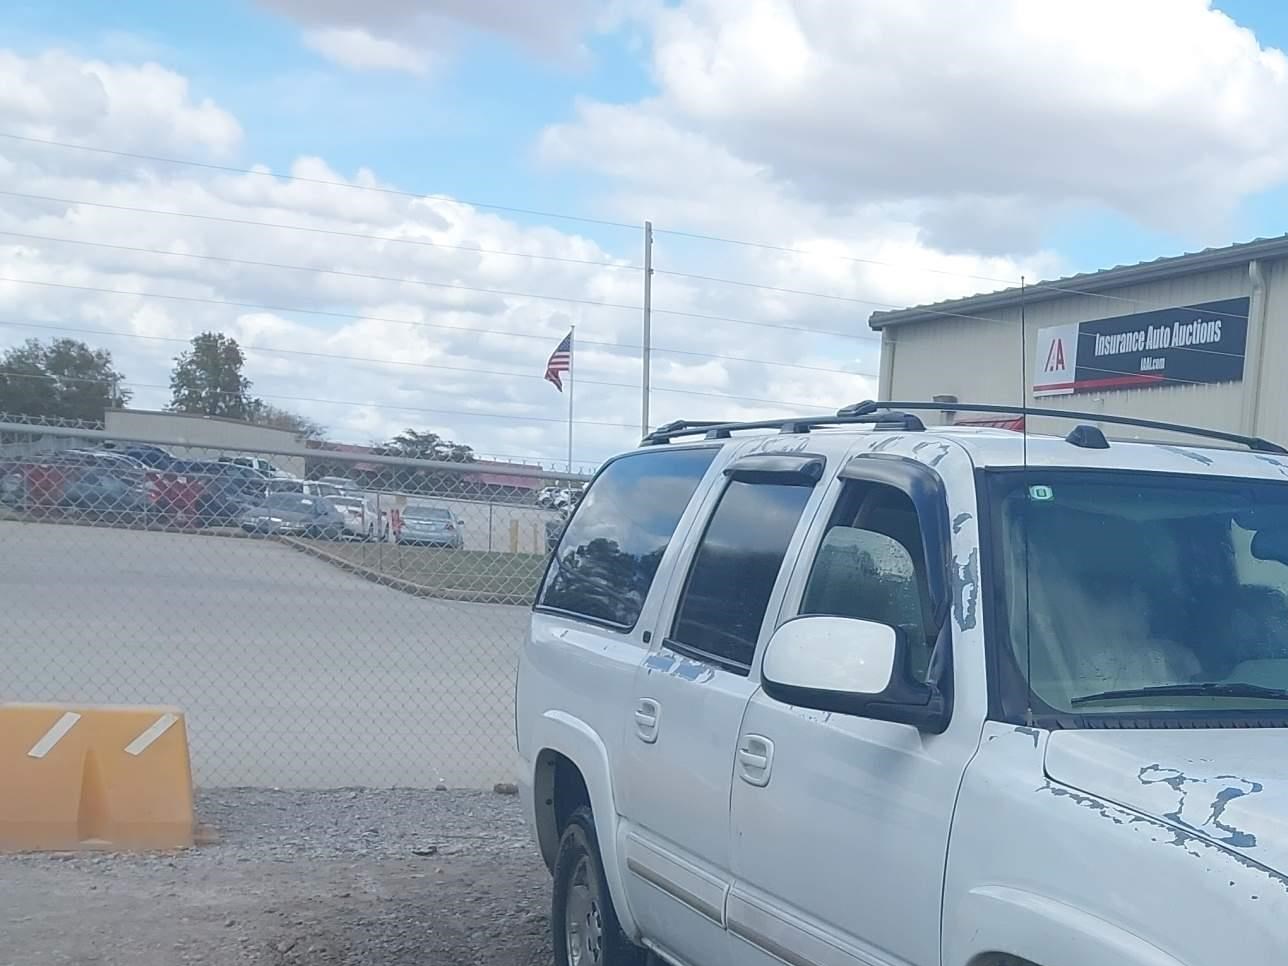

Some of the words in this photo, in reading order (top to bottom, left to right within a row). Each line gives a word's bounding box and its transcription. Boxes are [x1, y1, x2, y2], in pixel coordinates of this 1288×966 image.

[1094, 329, 1145, 357] Insurance
[1145, 325, 1171, 350] Auto
[1171, 319, 1222, 347] Auctions
